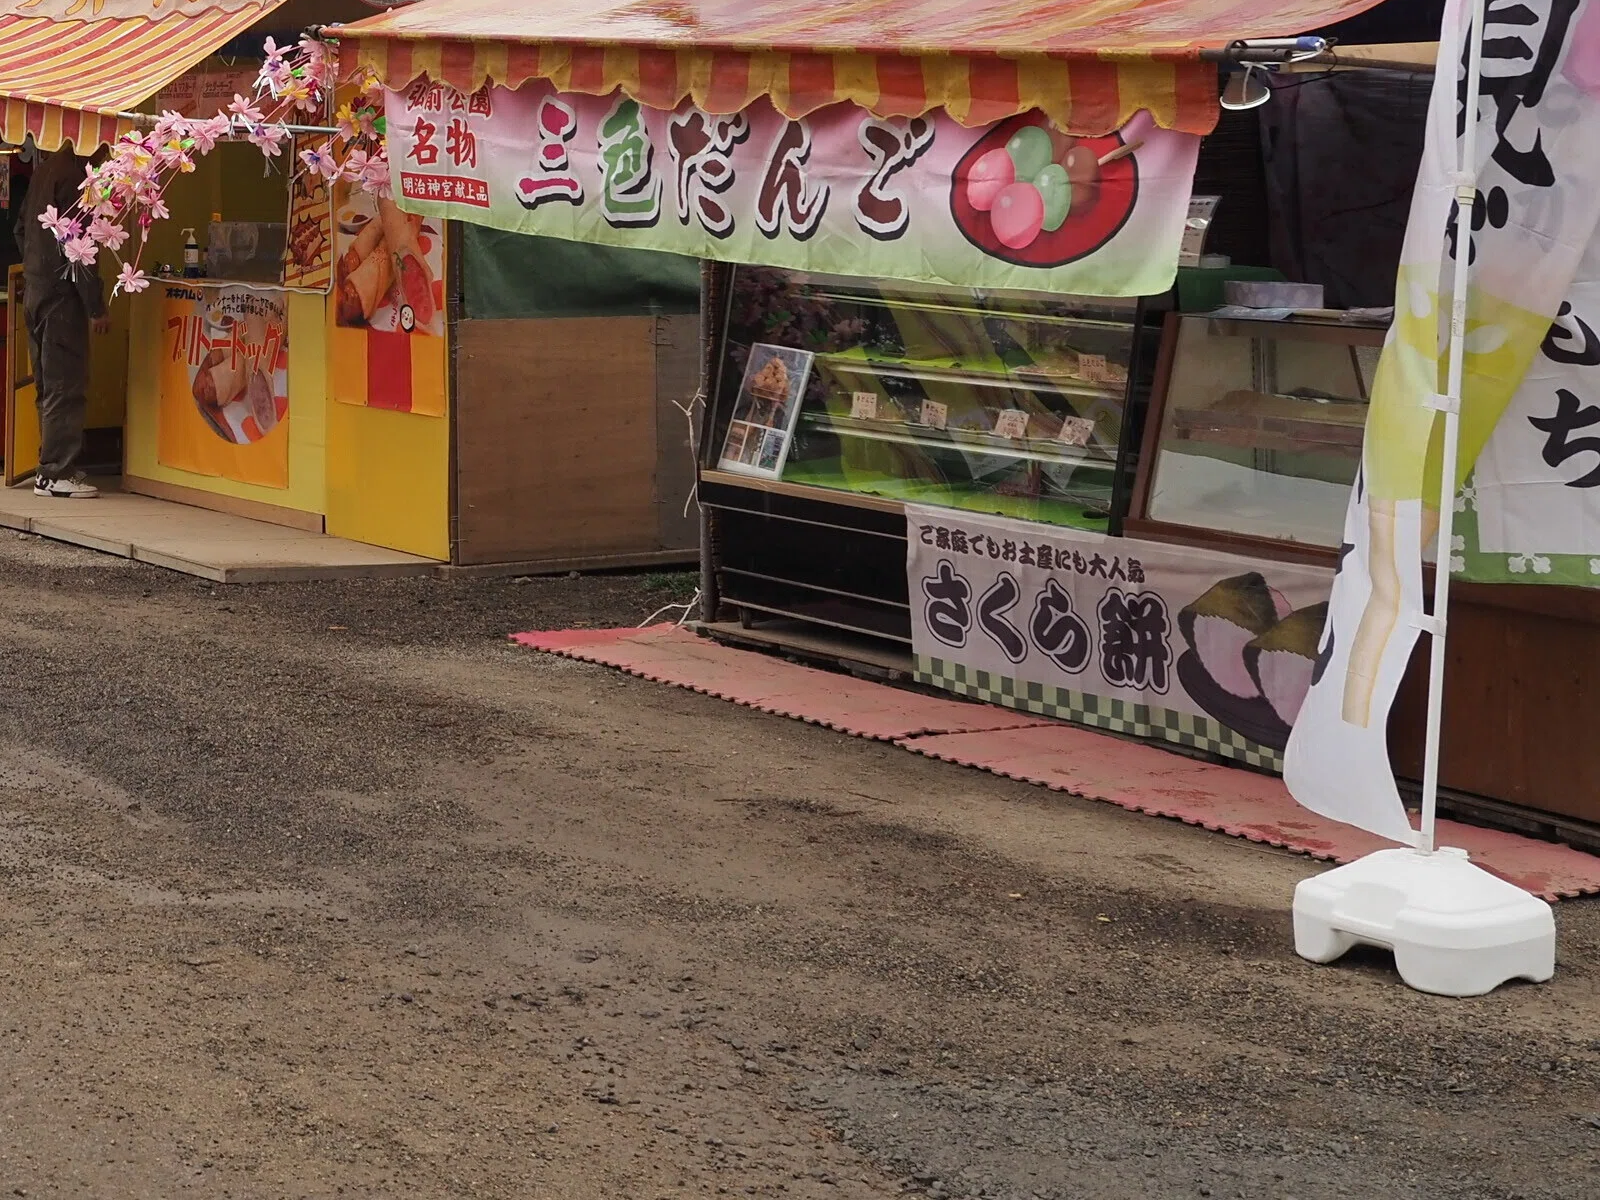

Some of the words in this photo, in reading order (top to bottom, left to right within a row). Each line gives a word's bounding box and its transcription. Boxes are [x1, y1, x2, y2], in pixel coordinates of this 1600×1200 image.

[406, 116, 478, 169] 名物
[515, 94, 936, 241] 三色だんご
[402, 177, 488, 202] 明治神宮献上品
[165, 288, 196, 300] オキハム
[167, 315, 283, 376] ブリトードッグ
[919, 524, 1146, 584] ご家庭でもお土産にも大人気
[921, 558, 1174, 695] さくら餅
